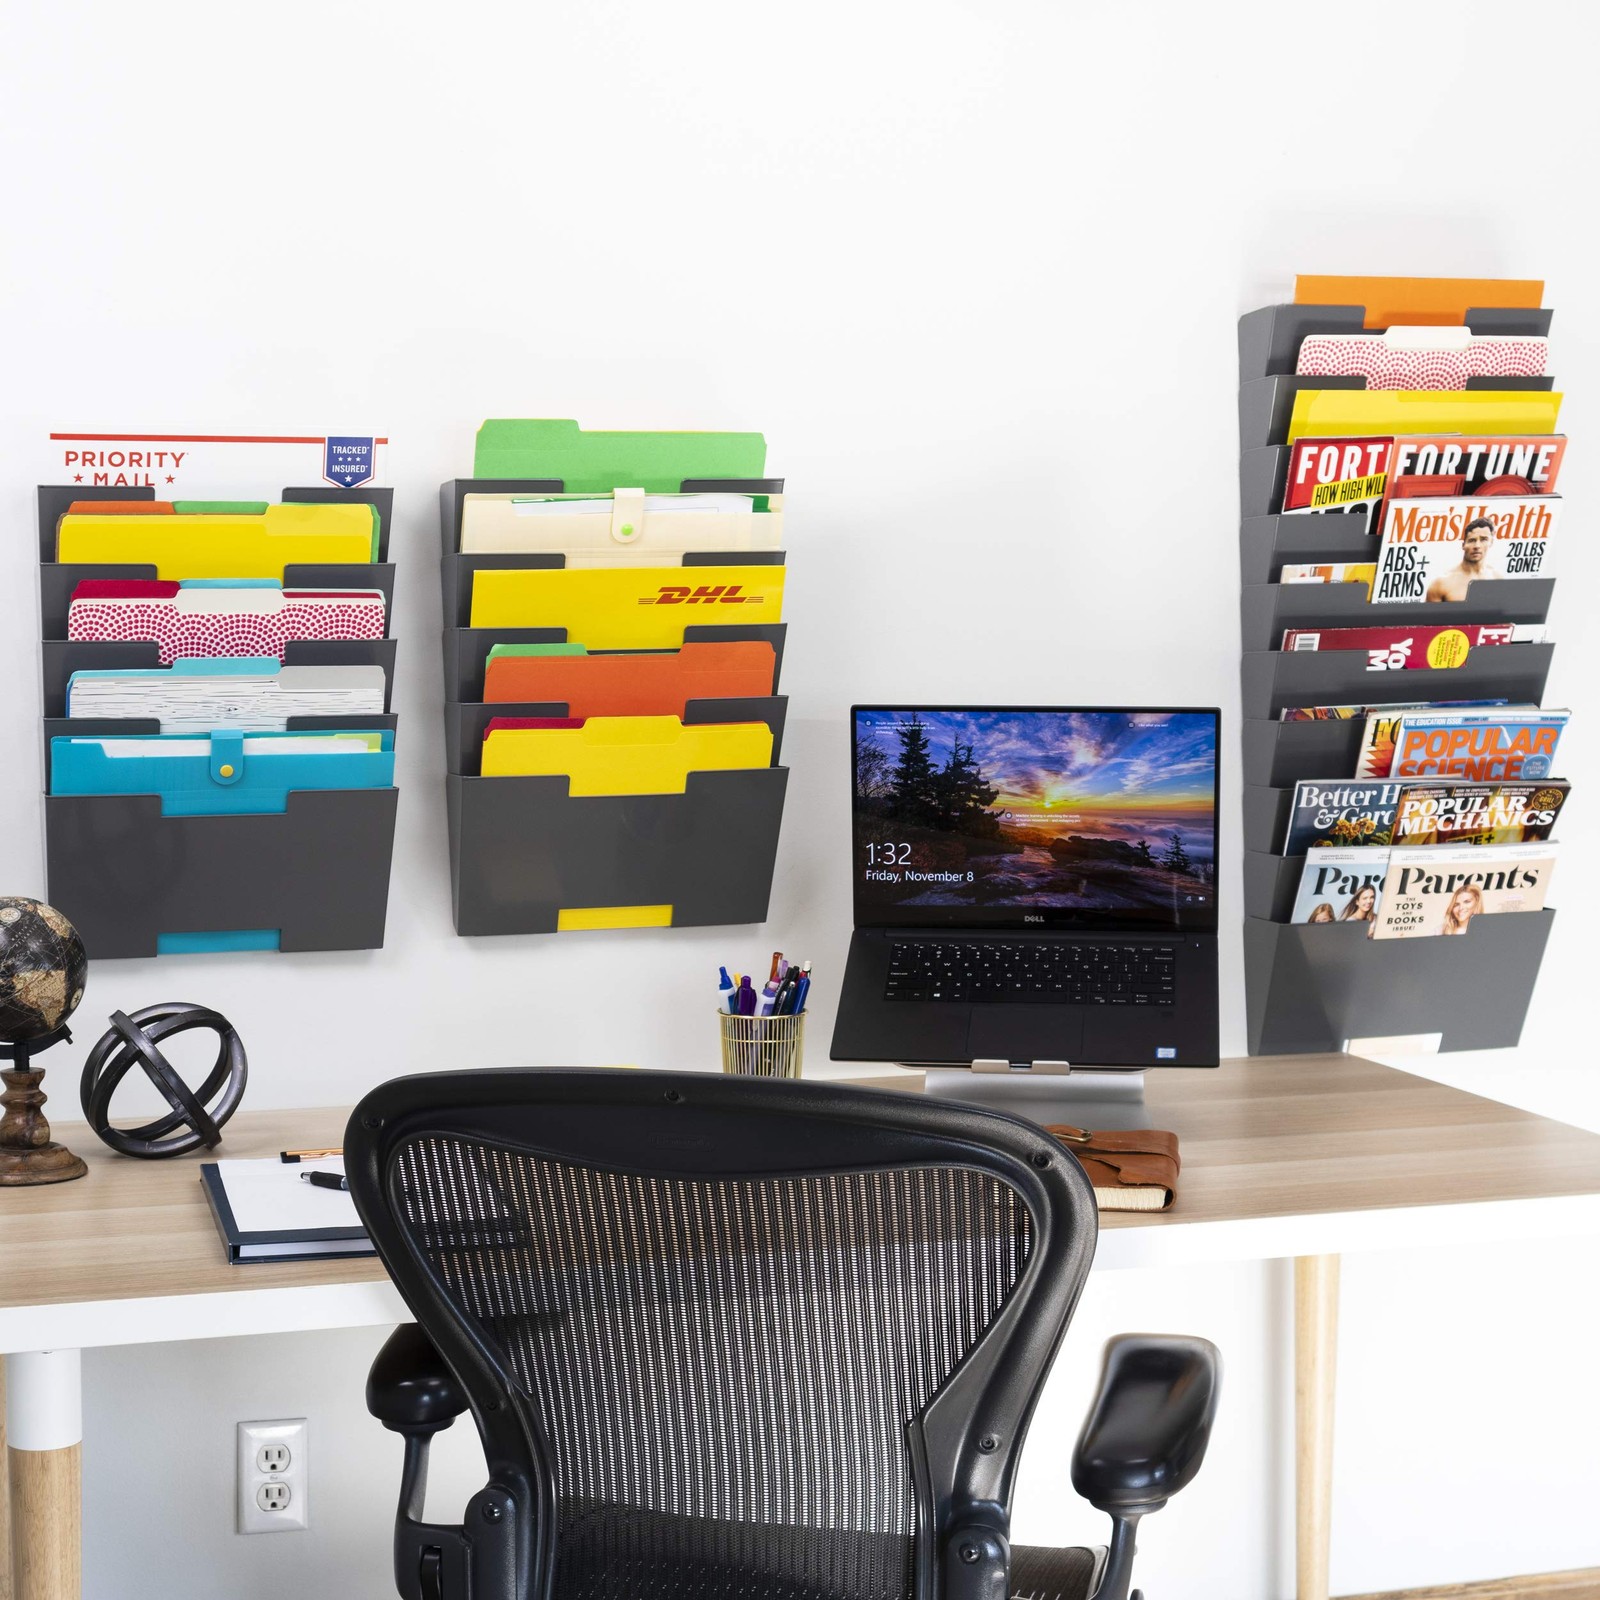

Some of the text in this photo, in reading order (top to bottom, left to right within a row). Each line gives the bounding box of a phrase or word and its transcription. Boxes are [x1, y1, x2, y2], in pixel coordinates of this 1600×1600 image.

[65, 450, 186, 468] PRIORITY
[332, 446, 368, 454] TRACKED
[332, 464, 366, 473] INSURED
[1394, 444, 1557, 483] FORTUNE
[94, 472, 155, 486] MAIL
[1314, 484, 1340, 506] HOW
[1340, 479, 1364, 501] HIGH
[1506, 541, 1546, 558] 20 LBS
[1506, 557, 1542, 574] GONE!
[1378, 571, 1426, 599] ARMS
[655, 585, 747, 605] DHL
[1416, 718, 1447, 726] EDUCATION
[1446, 717, 1463, 725] ISSUE
[1403, 727, 1558, 759] POPULAR
[1400, 755, 1525, 783] SCIENCE
[1298, 786, 1377, 808] Better
[1402, 796, 1527, 818] POPULAR
[1397, 810, 1555, 836] MECHANICS
[866, 843, 912, 865] 1:32
[866, 870, 974, 883] Friday, November 8
[1395, 902, 1423, 910] TOYS
[1024, 915, 1045, 923] DELL
[1386, 916, 1424, 925] BOOKS
